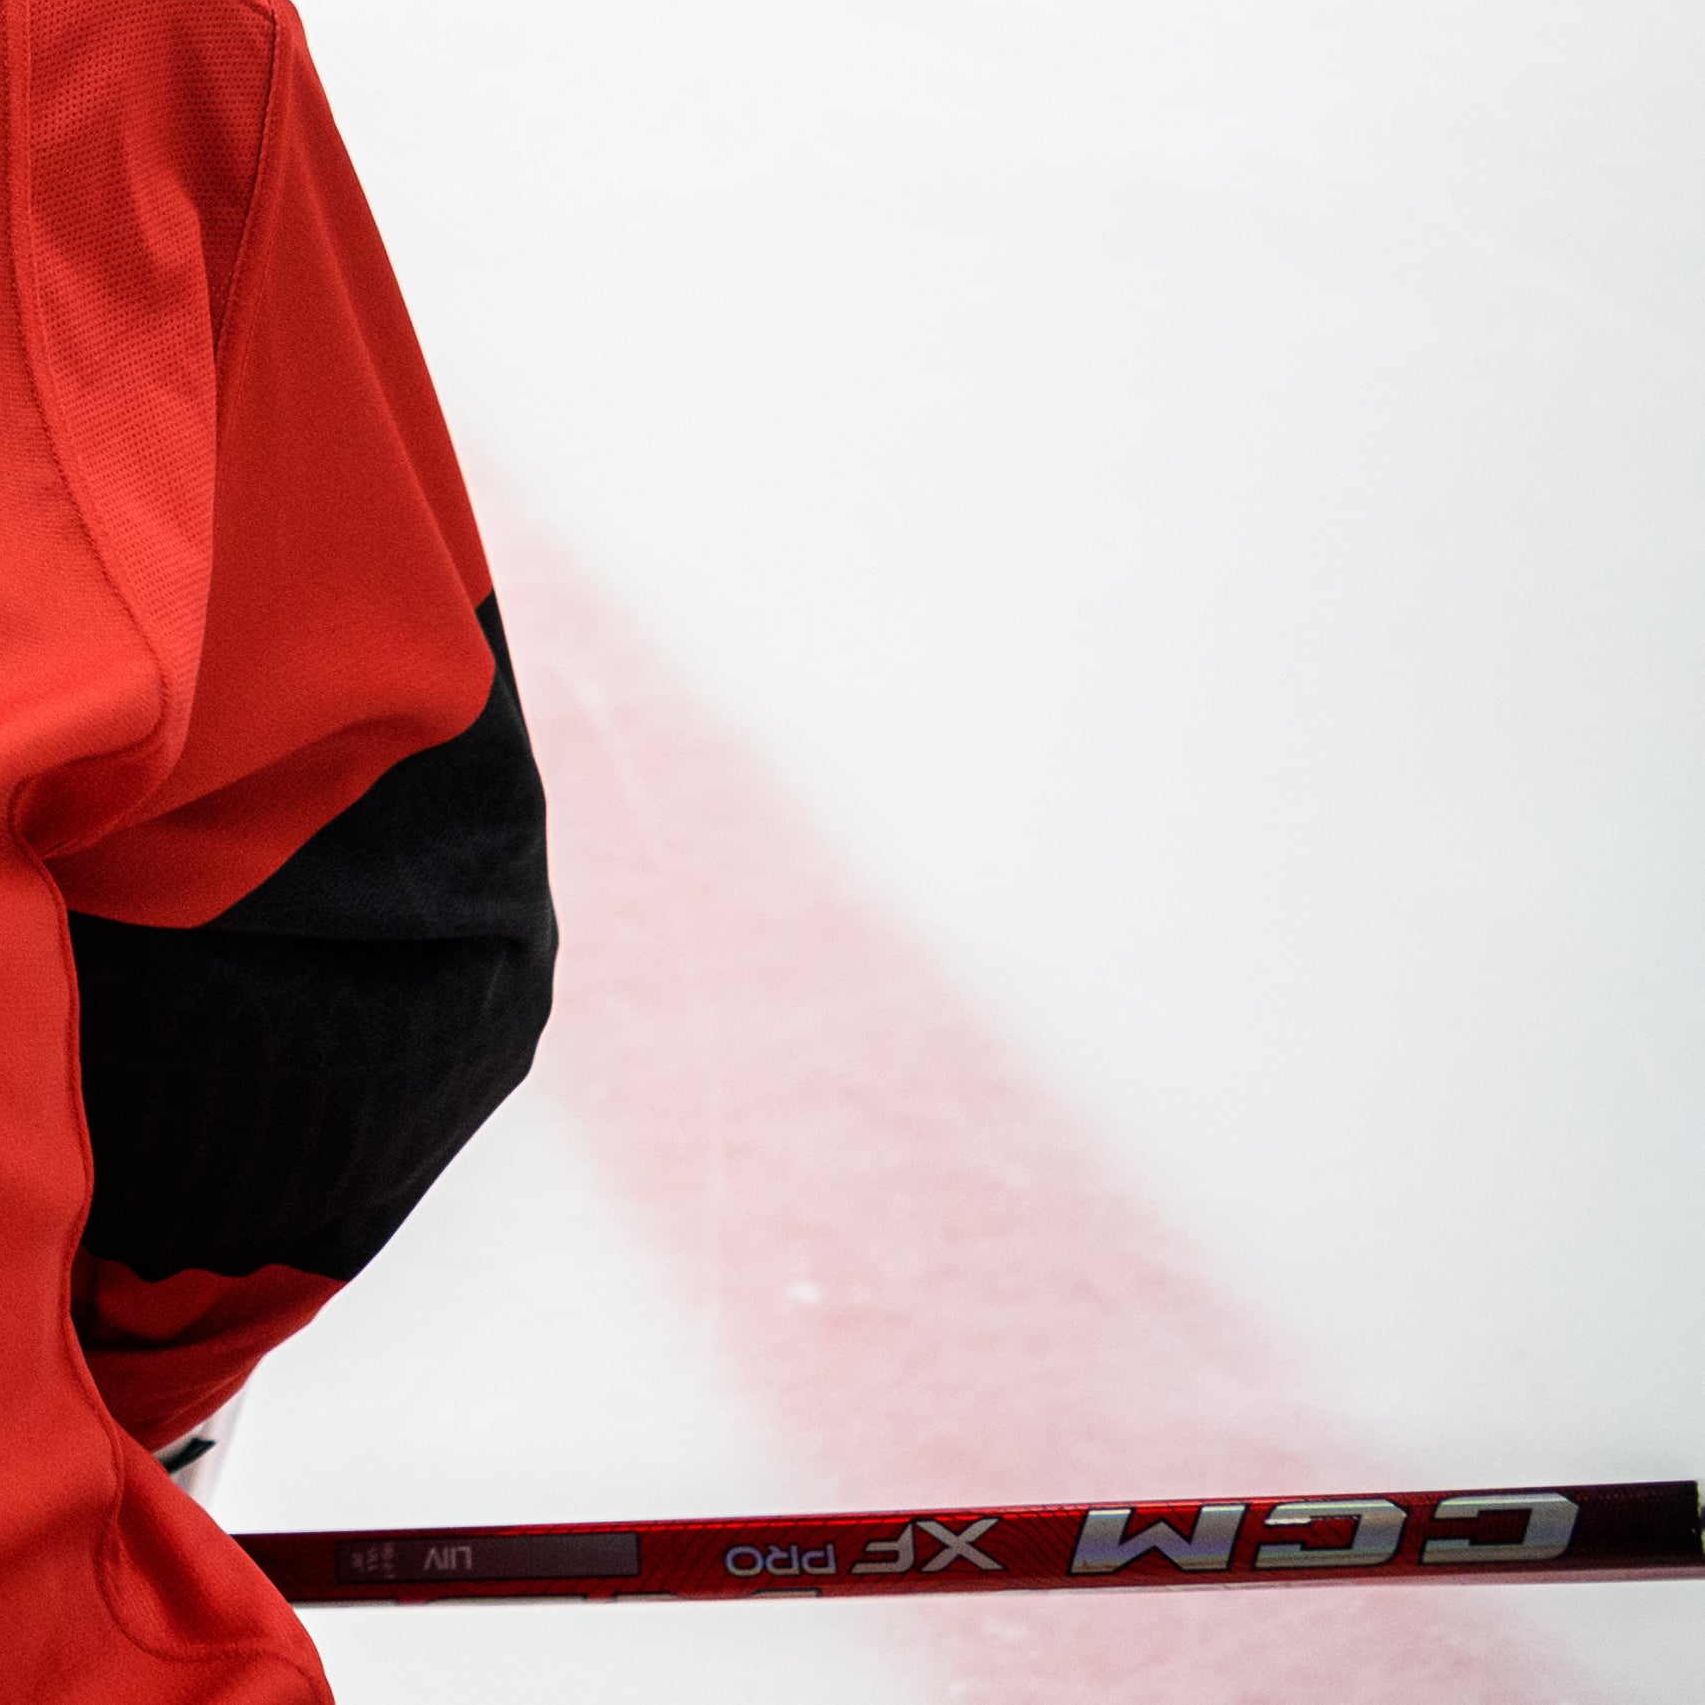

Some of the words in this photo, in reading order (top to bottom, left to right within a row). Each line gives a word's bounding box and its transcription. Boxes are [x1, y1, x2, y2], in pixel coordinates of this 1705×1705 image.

[853, 1517, 1006, 1574] XF
[1068, 1492, 1580, 1576] CCM
[422, 1544, 475, 1576] LIV
[724, 1541, 838, 1578] PRO
